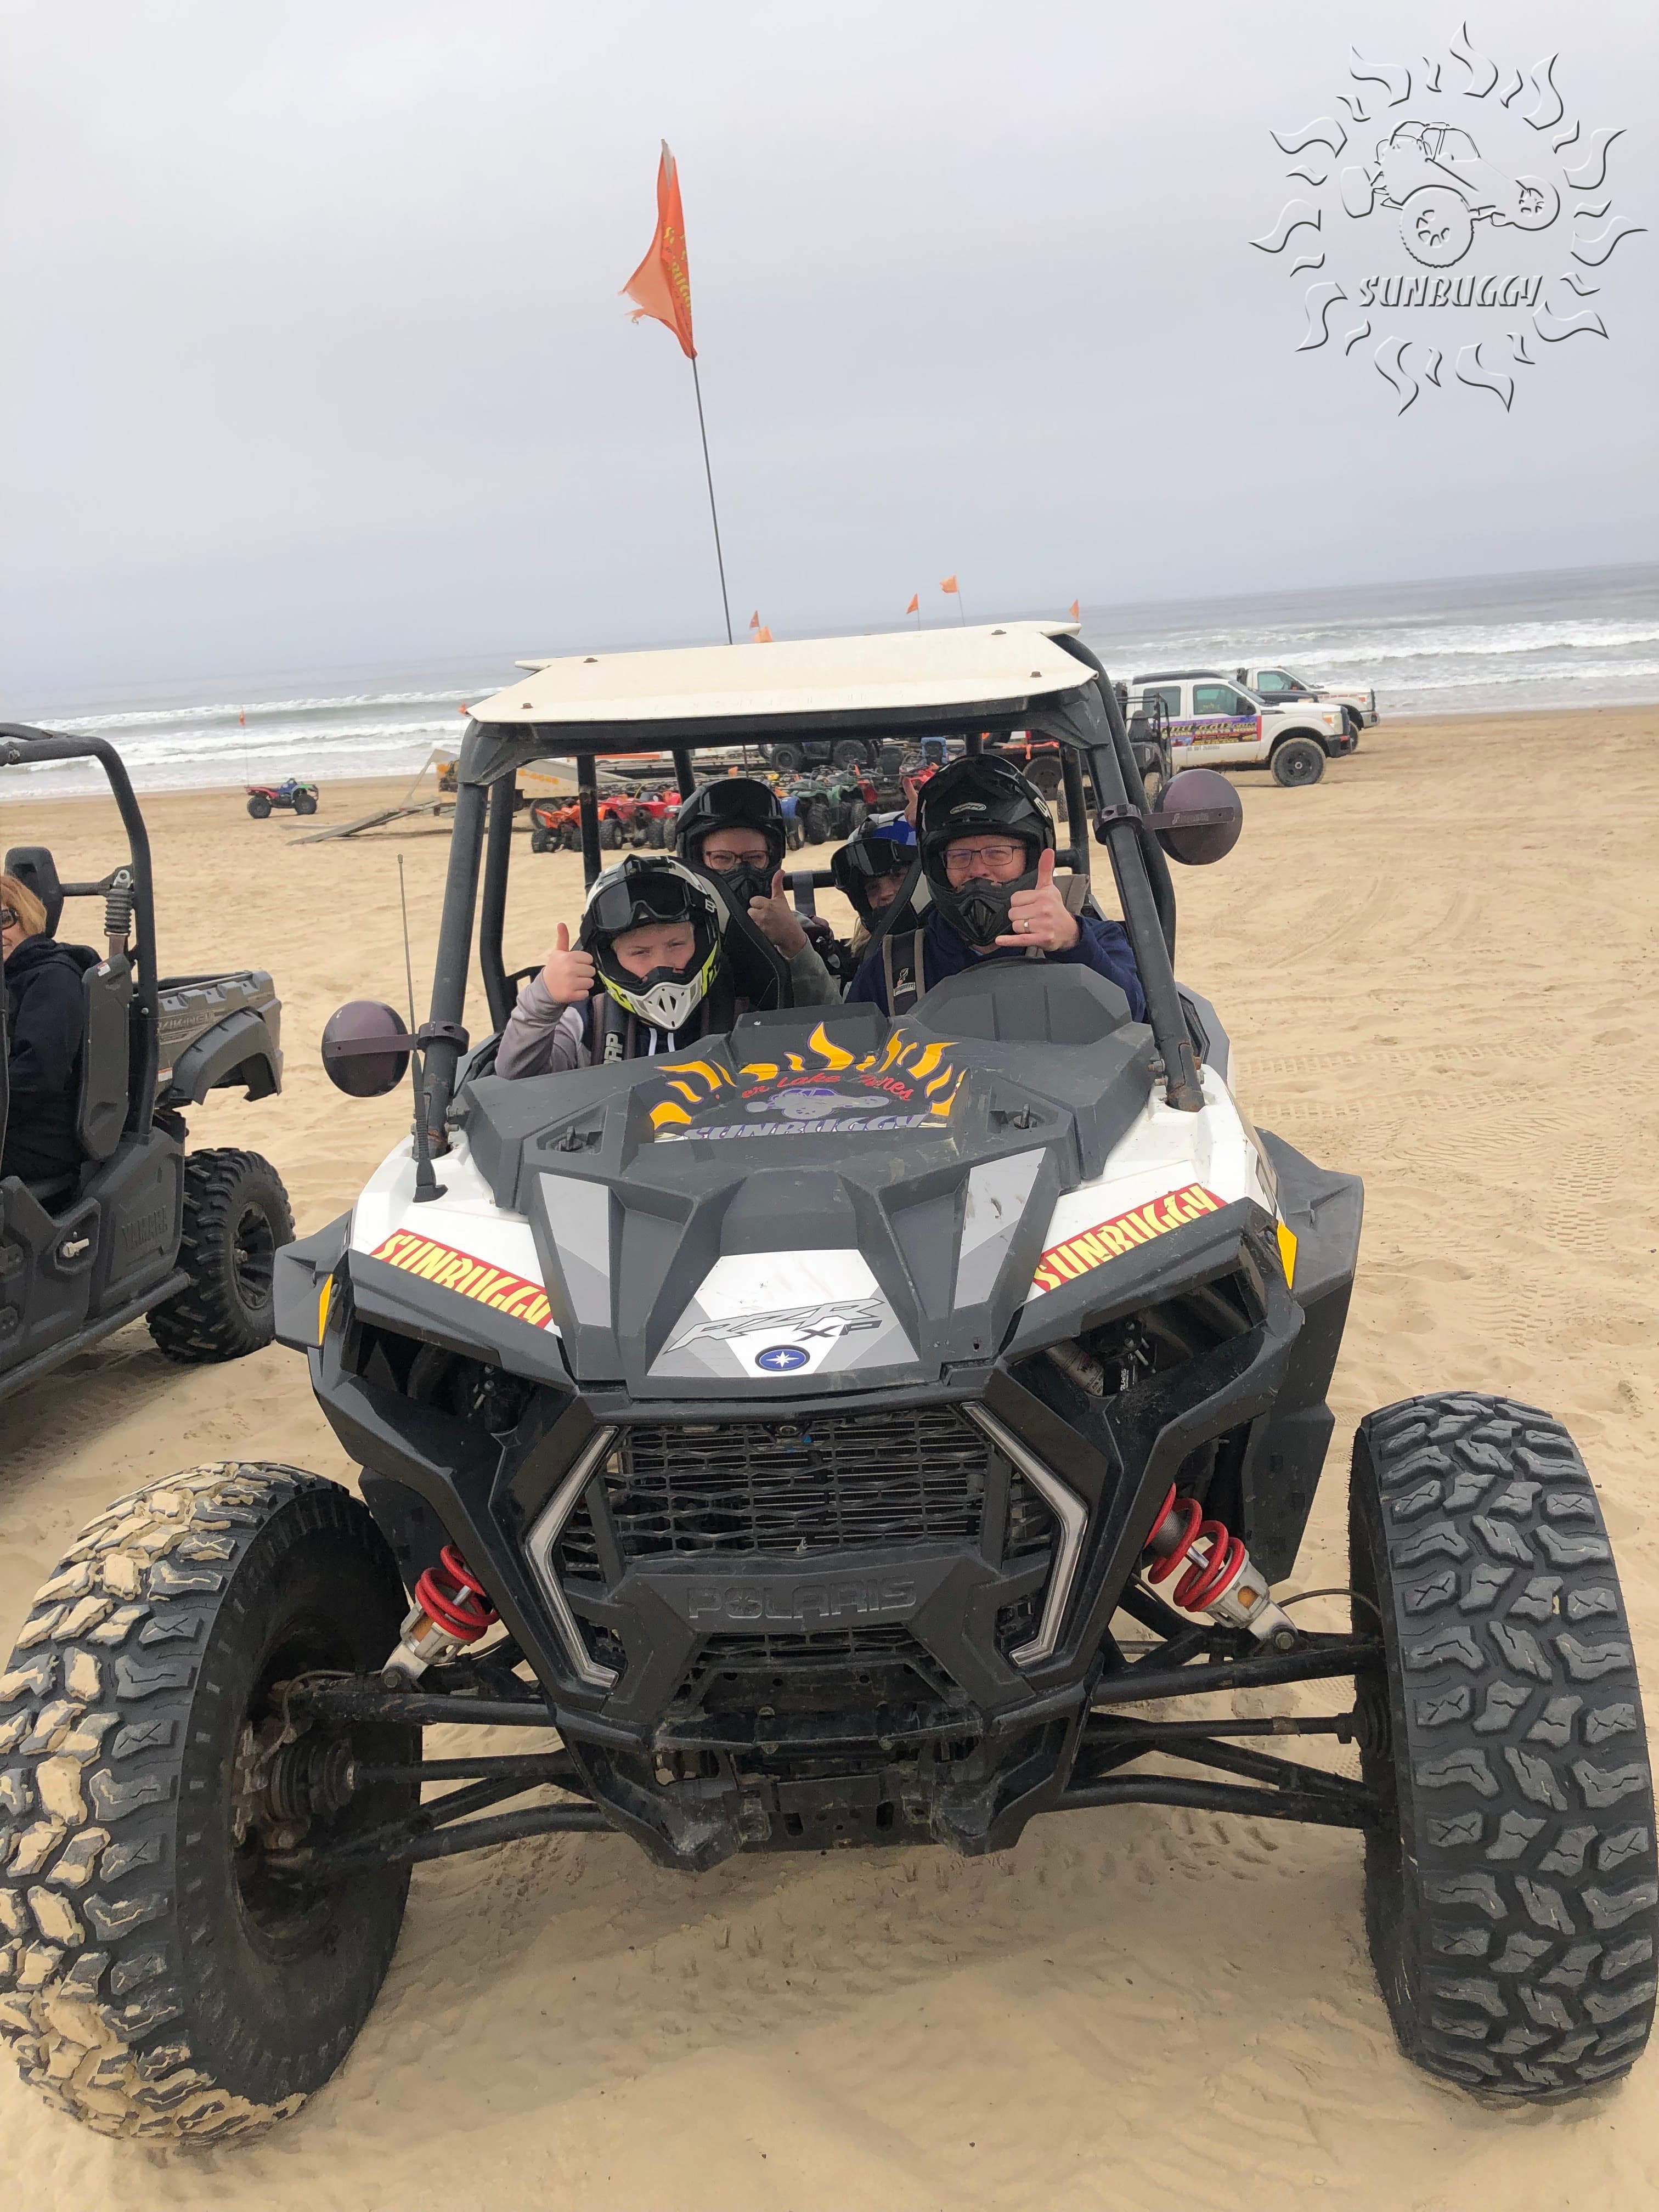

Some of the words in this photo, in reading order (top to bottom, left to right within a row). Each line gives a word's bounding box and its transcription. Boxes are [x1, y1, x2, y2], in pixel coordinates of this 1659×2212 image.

[662, 1297, 885, 1355] RZR
[793, 1319, 882, 1342] XP
[689, 1576, 917, 1618] POLARIS
